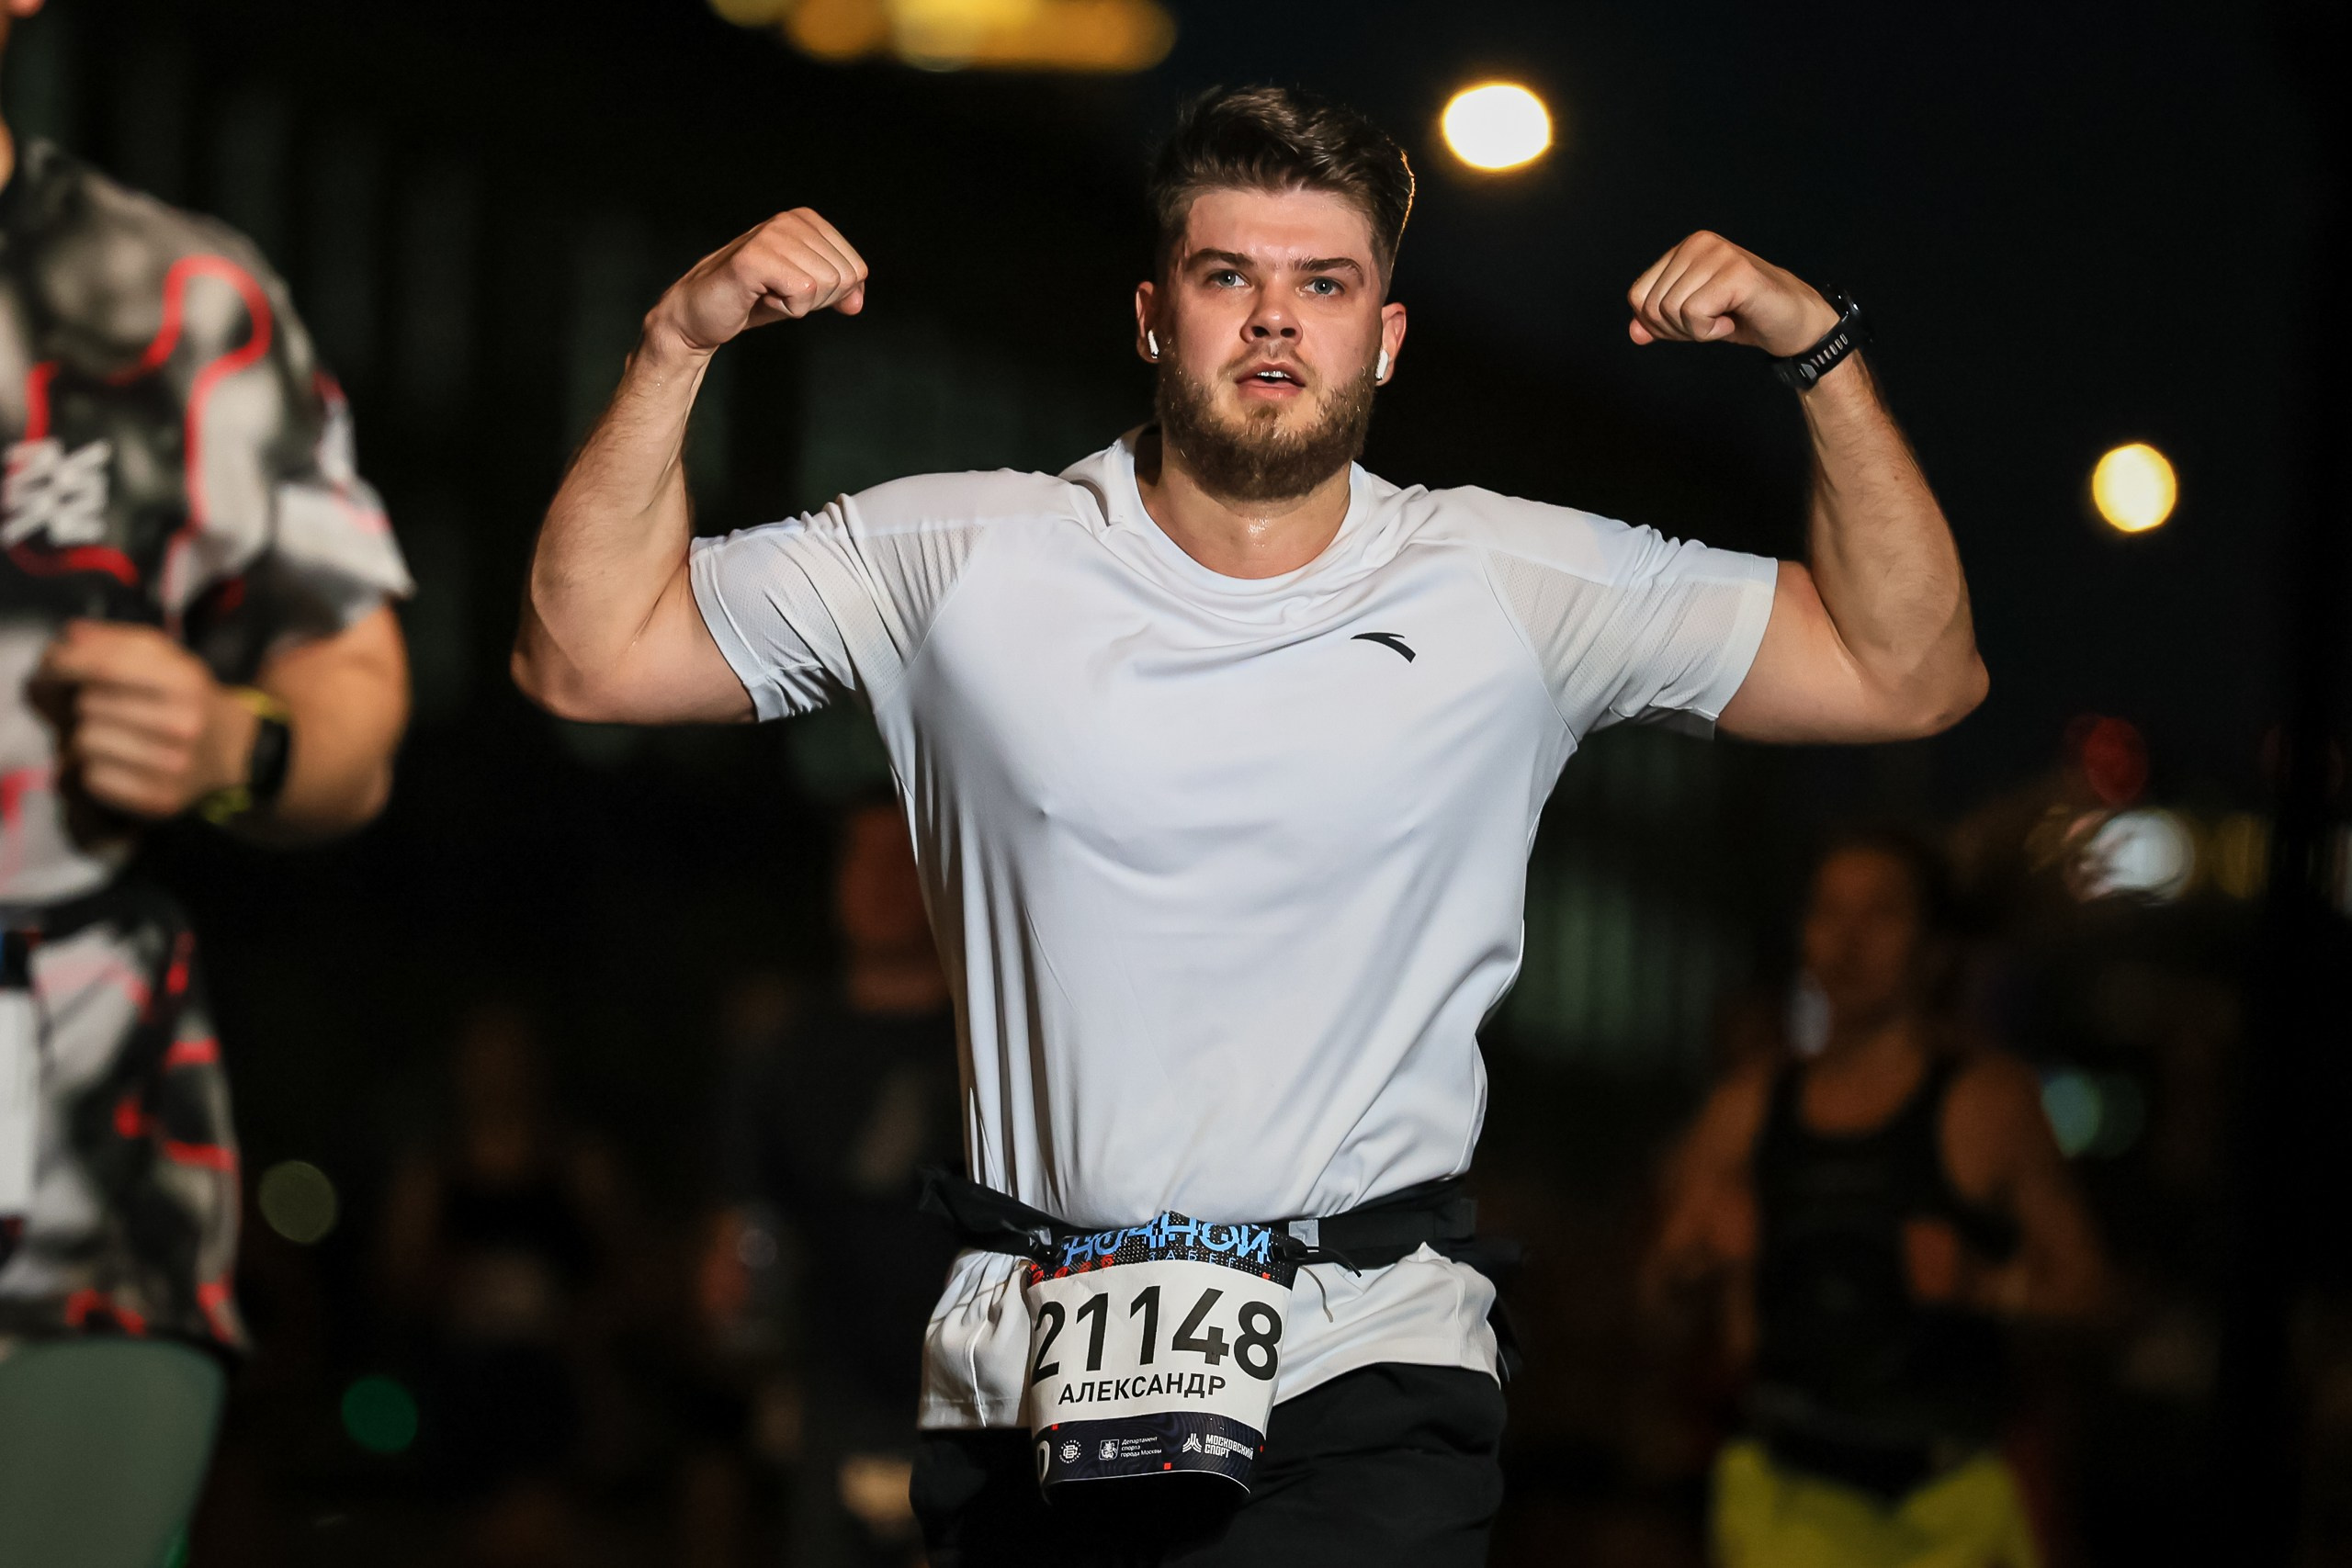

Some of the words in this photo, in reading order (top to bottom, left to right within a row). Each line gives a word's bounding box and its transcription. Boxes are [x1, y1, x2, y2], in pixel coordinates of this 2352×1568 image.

[1031, 1284, 1283, 1388] 21148
[1057, 1372, 1227, 1405] АЛЕКСАНДР
[1204, 1444, 1231, 1459] СПОРТ
[1205, 1433, 1254, 1461] МОСКОВСКИЙ
